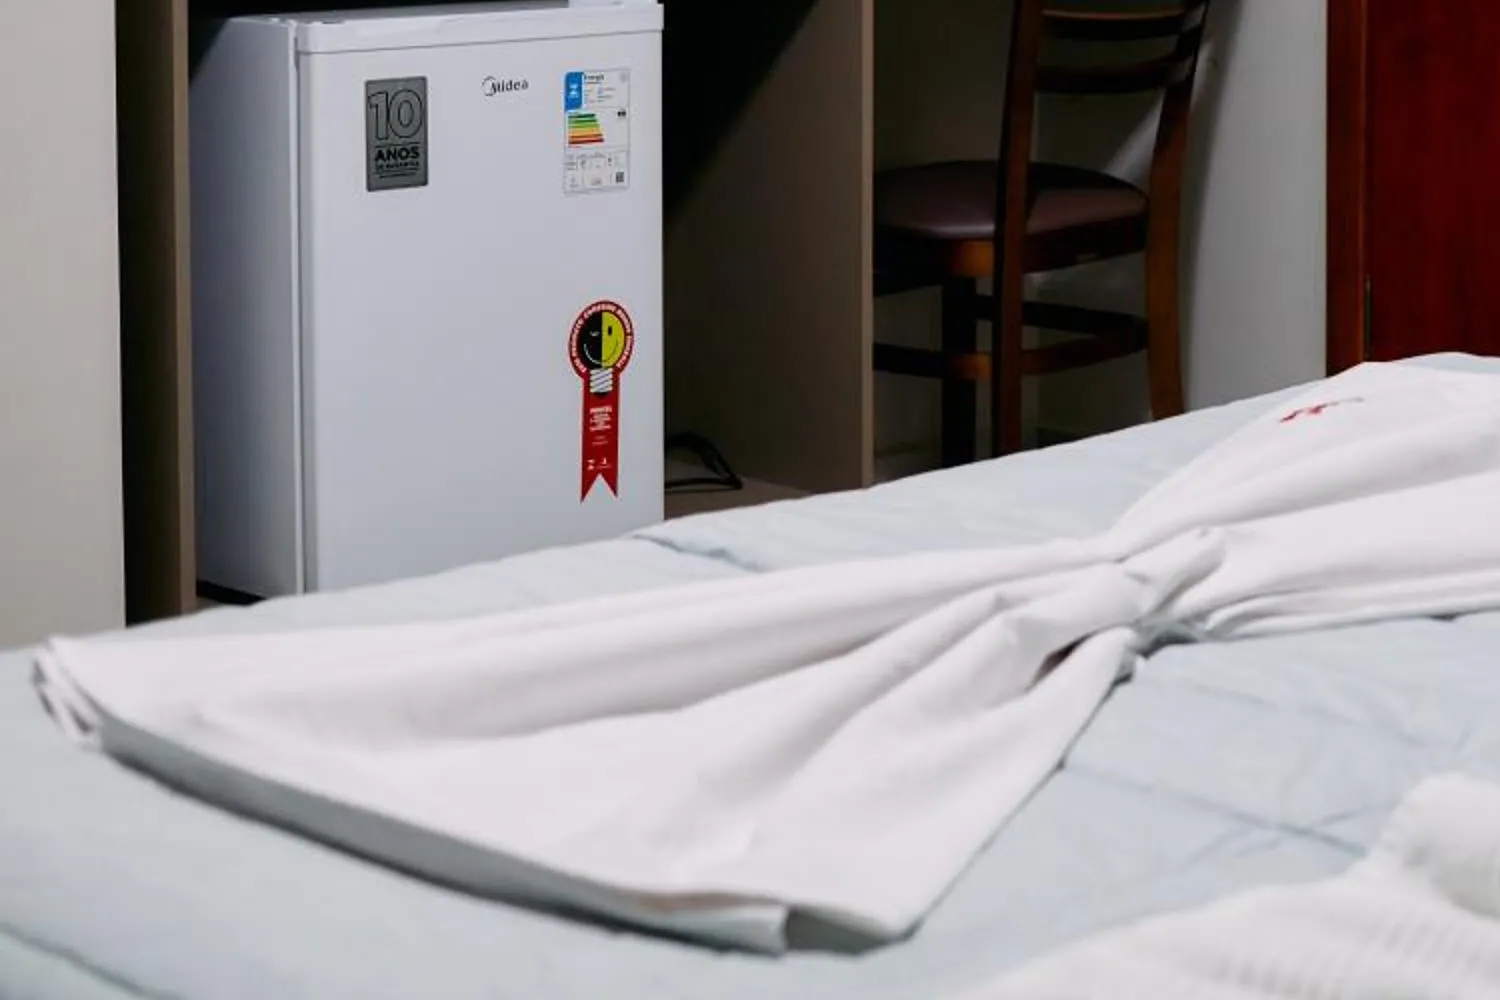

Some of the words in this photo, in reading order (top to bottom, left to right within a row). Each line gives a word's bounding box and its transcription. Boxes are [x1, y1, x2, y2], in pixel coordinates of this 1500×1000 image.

[481, 76, 529, 96] Midea
[368, 89, 422, 140] 10
[375, 146, 420, 162] ANOS
